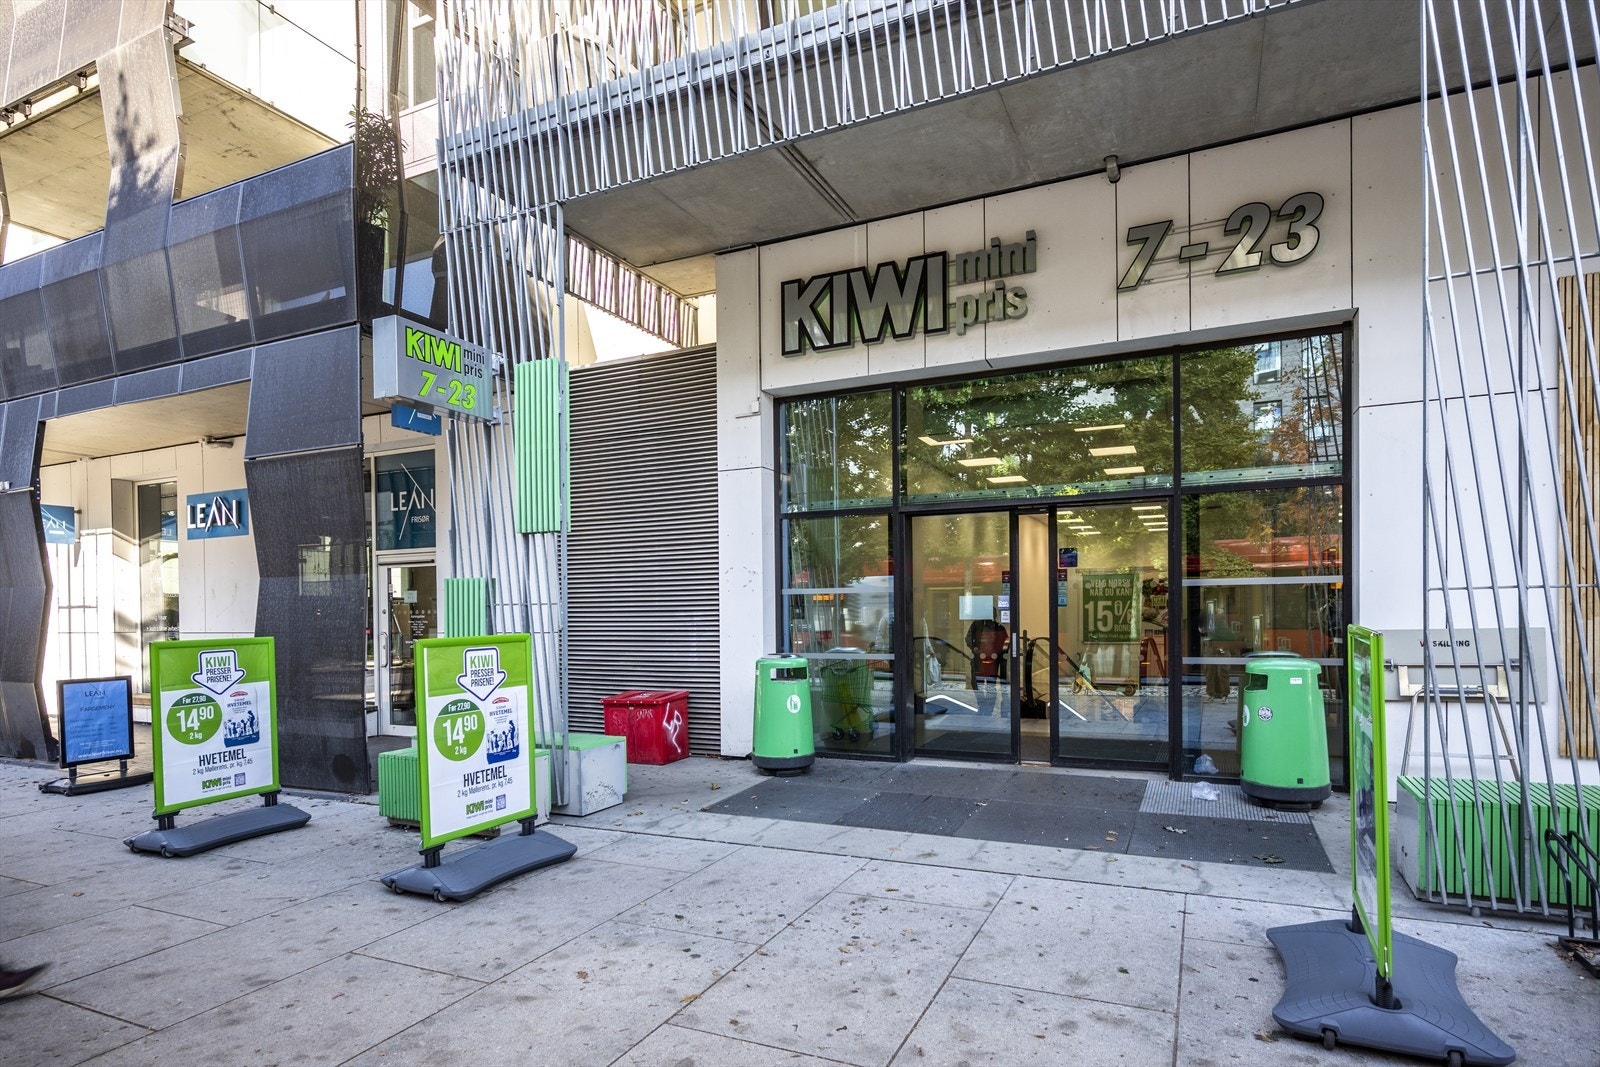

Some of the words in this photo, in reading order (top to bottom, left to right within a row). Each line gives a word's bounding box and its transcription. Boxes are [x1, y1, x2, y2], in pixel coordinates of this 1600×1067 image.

[780, 249, 949, 357] KIWI
[956, 230, 1037, 285] mini
[956, 280, 1028, 335] pris
[405, 325, 462, 373] KIWI
[464, 348, 484, 365] mini
[464, 364, 482, 378] pris
[390, 487, 436, 512] LEAN
[186, 496, 241, 532] LEAN
[1105, 588, 1114, 596] DU
[1084, 600, 1135, 632] 15%
[206, 656, 231, 668] KIWI
[470, 655, 494, 669] KIWI
[206, 667, 231, 676] PRESSER
[470, 668, 494, 678] PRESSER
[206, 675, 232, 683] PRISENE!
[470, 678, 494, 687] PRISENE!
[199, 748, 246, 766] HVETEMEL
[455, 746, 459, 755] 2
[460, 746, 467, 755] kg
[202, 777, 222, 789] KIWI
[464, 765, 507, 787] HVETEMEL
[466, 800, 484, 815] KIWI
